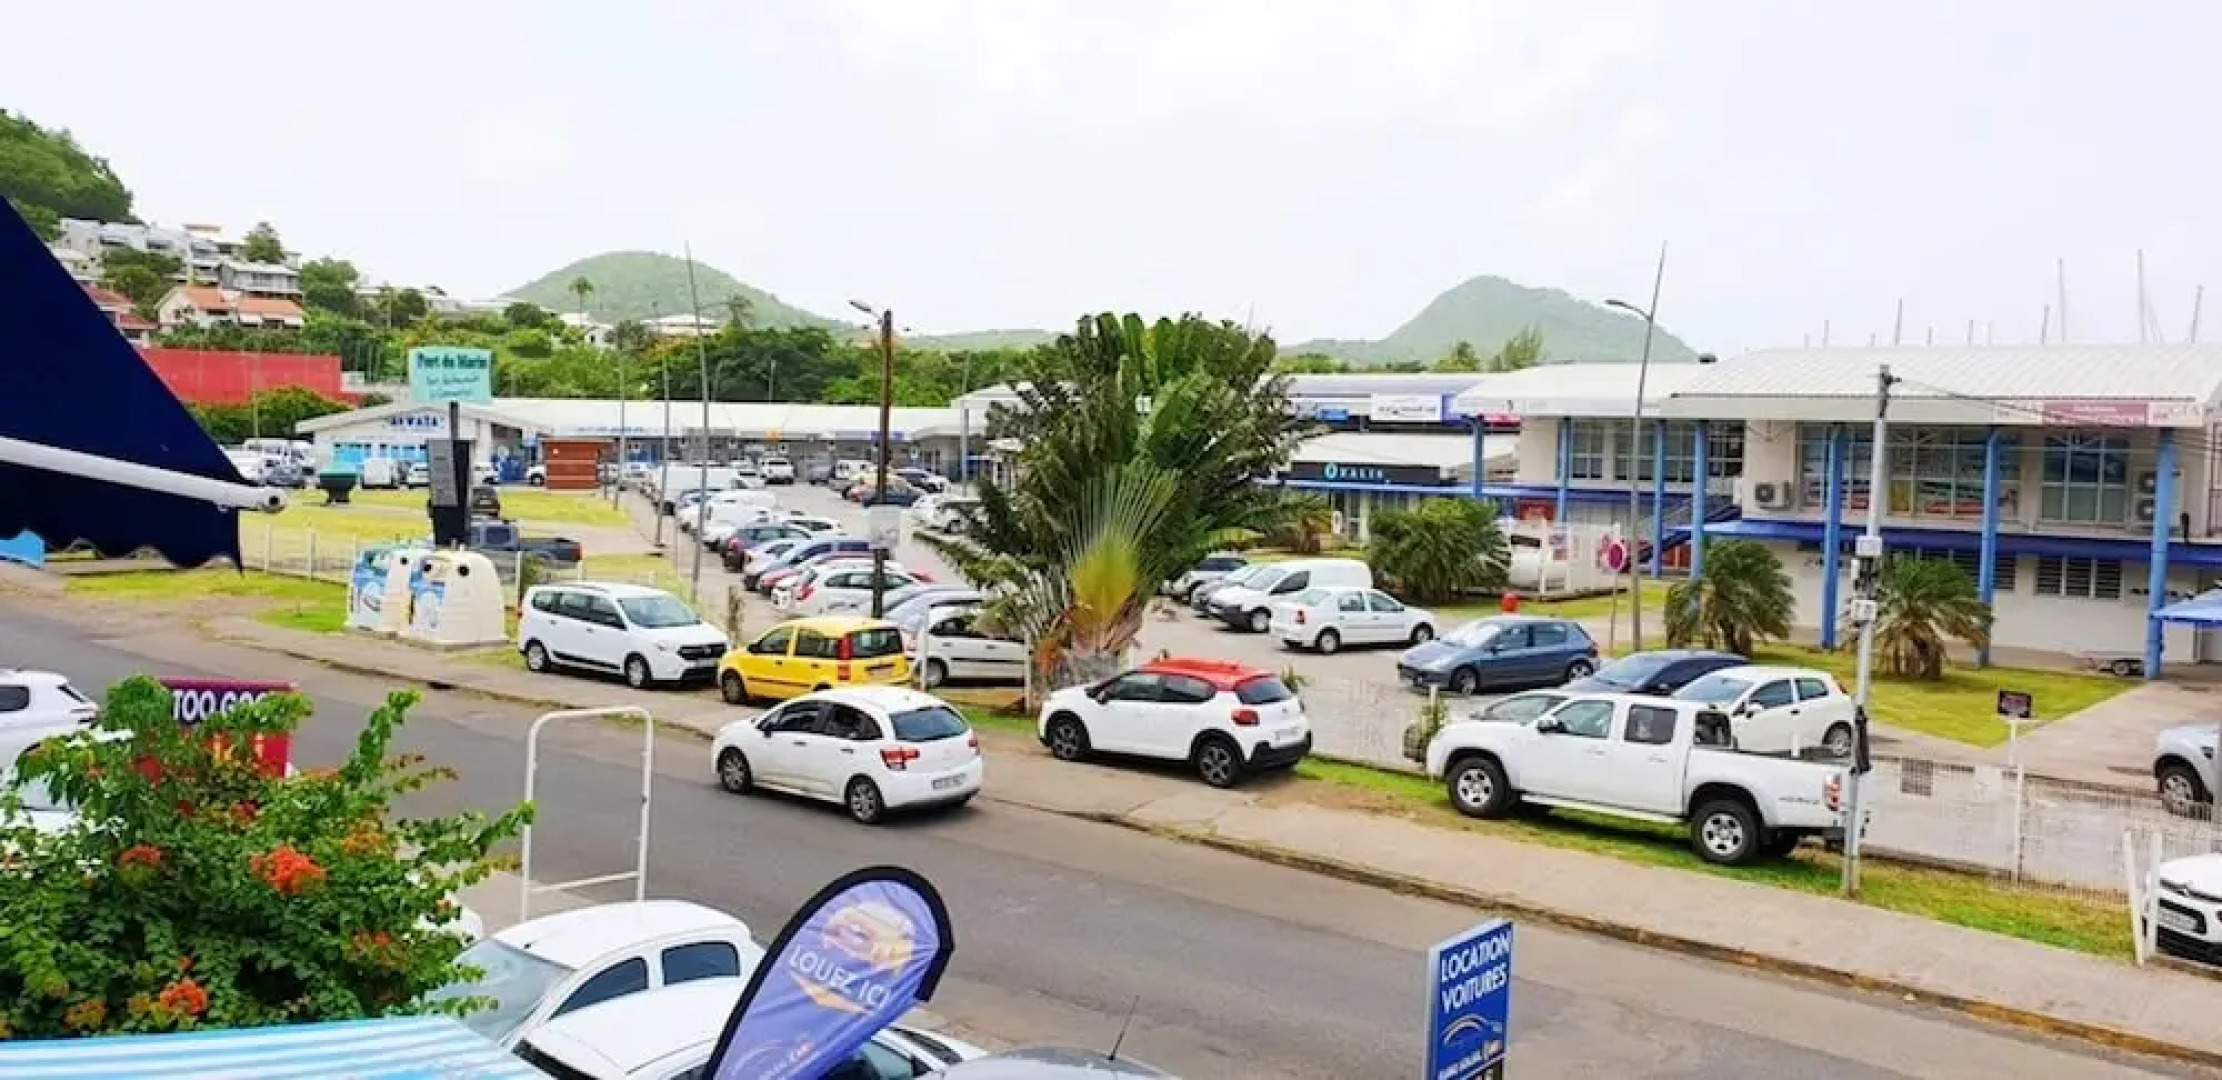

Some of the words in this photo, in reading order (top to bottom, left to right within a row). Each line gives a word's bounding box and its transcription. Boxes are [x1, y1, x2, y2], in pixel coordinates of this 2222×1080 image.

[172, 689, 217, 722] TOO
[788, 944, 858, 994] LOUEZ
[1440, 929, 1512, 983] LOCATION
[1440, 961, 1508, 1014] VOITURES
